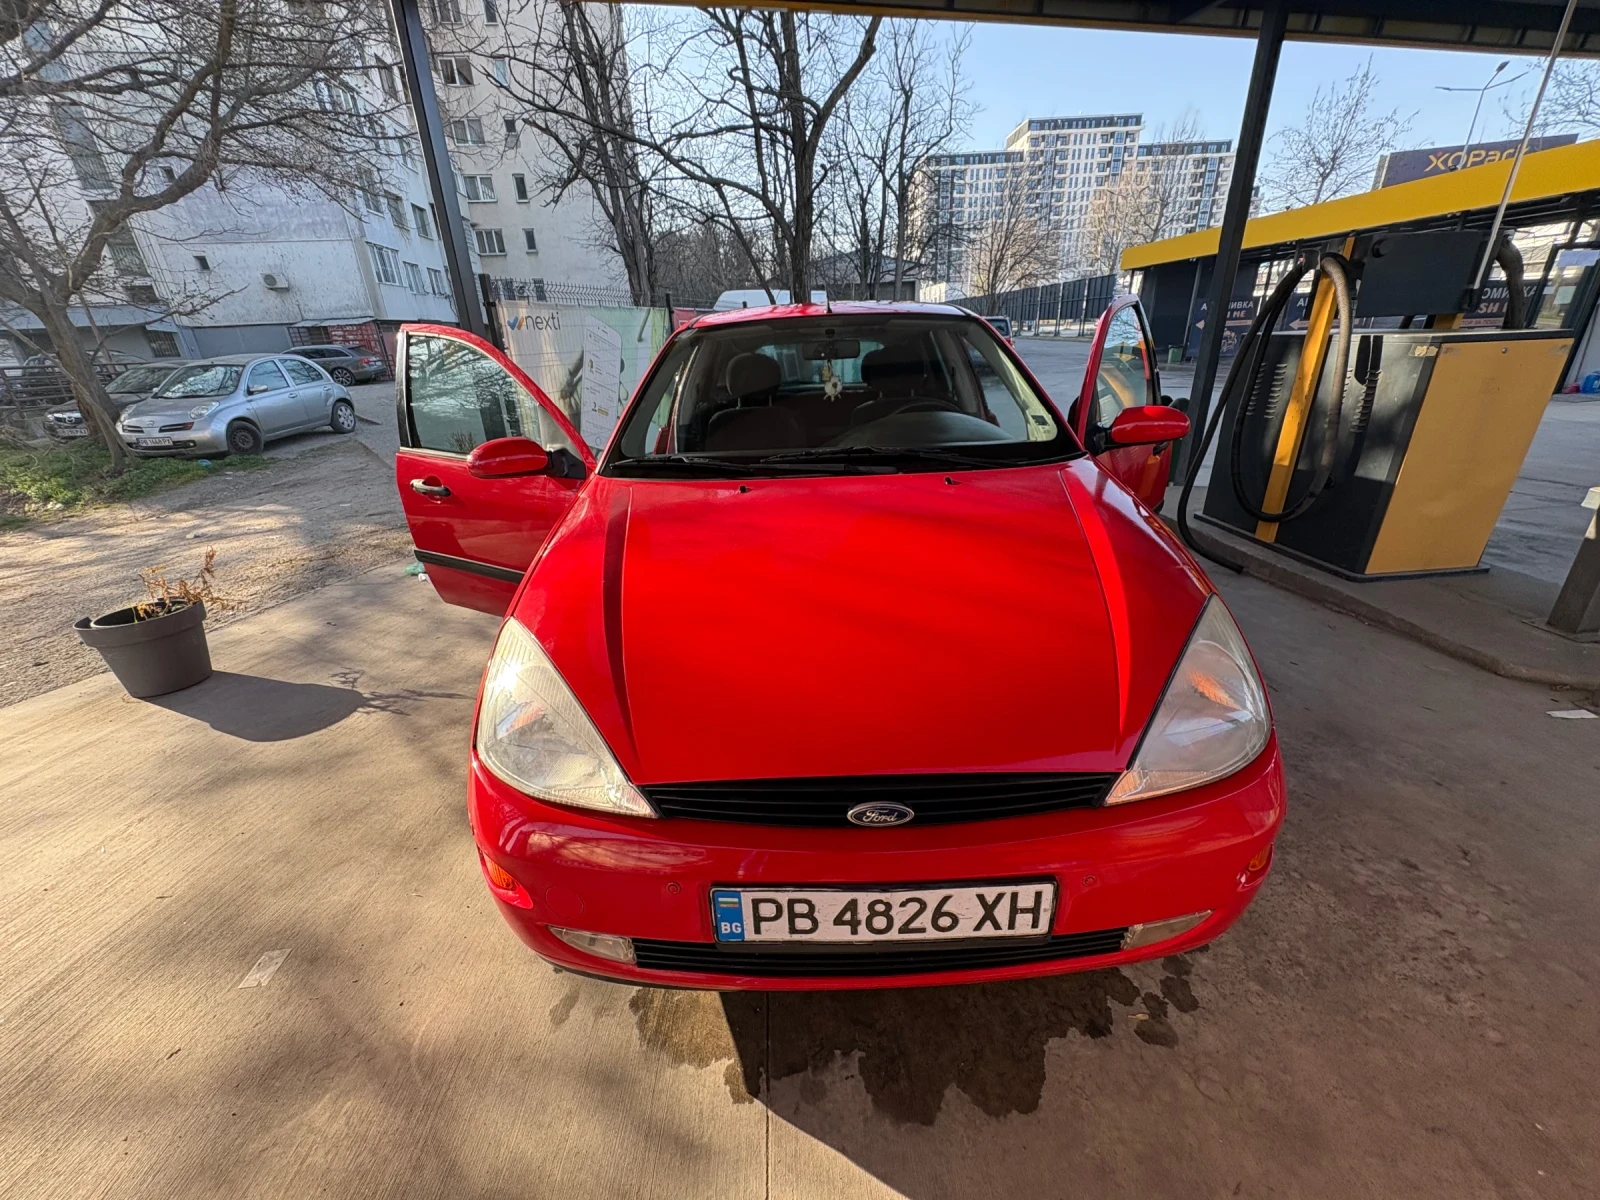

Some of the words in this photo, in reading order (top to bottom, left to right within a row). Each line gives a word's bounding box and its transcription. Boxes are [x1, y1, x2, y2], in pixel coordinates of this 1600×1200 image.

[525, 312, 561, 330] nexti
[862, 809, 898, 822] Ford
[750, 897, 819, 935] PB
[833, 894, 959, 936] 4826
[972, 890, 1044, 932] XH
[721, 921, 742, 934] BG
